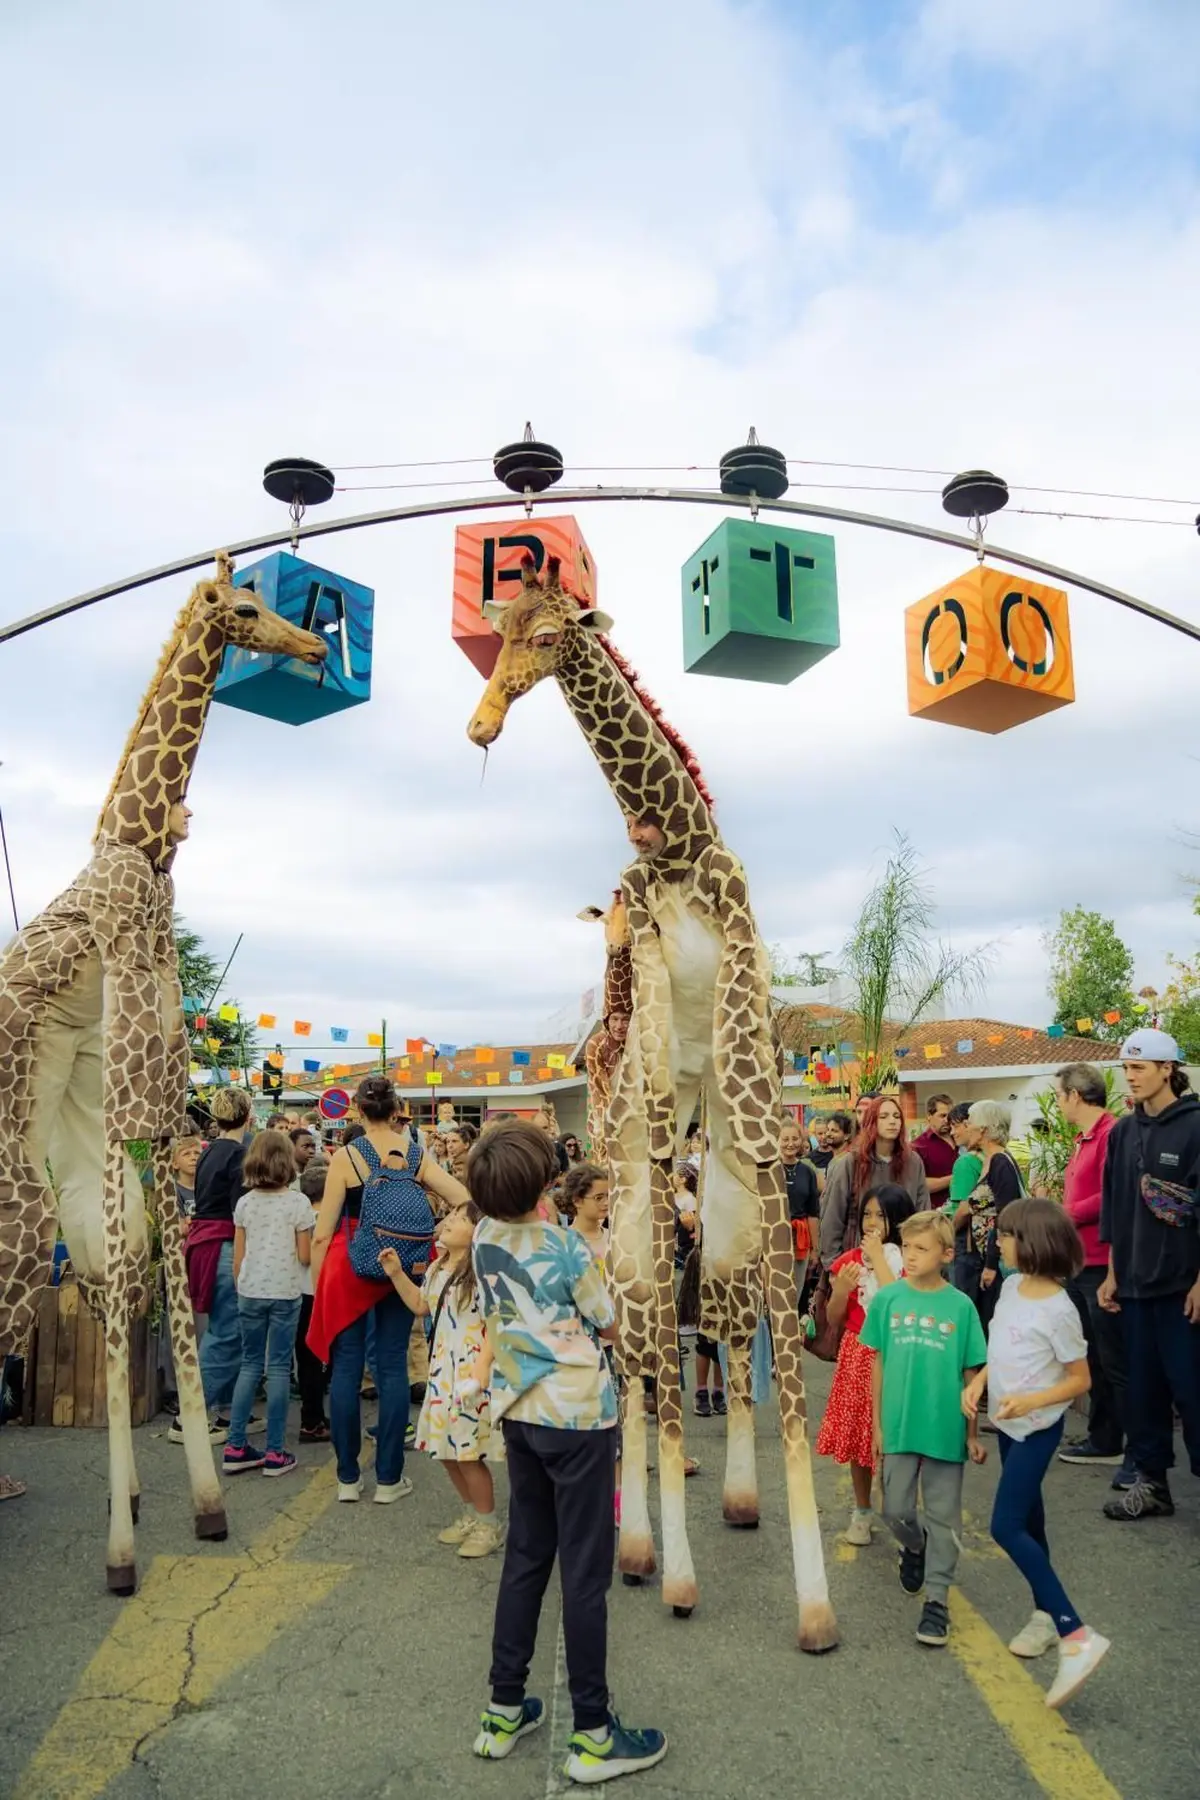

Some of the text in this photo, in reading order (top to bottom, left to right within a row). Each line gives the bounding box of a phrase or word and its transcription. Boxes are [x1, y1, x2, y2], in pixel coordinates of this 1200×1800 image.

[749, 541, 814, 624] T
[301, 581, 352, 679] A
[1000, 592, 1055, 676] O
